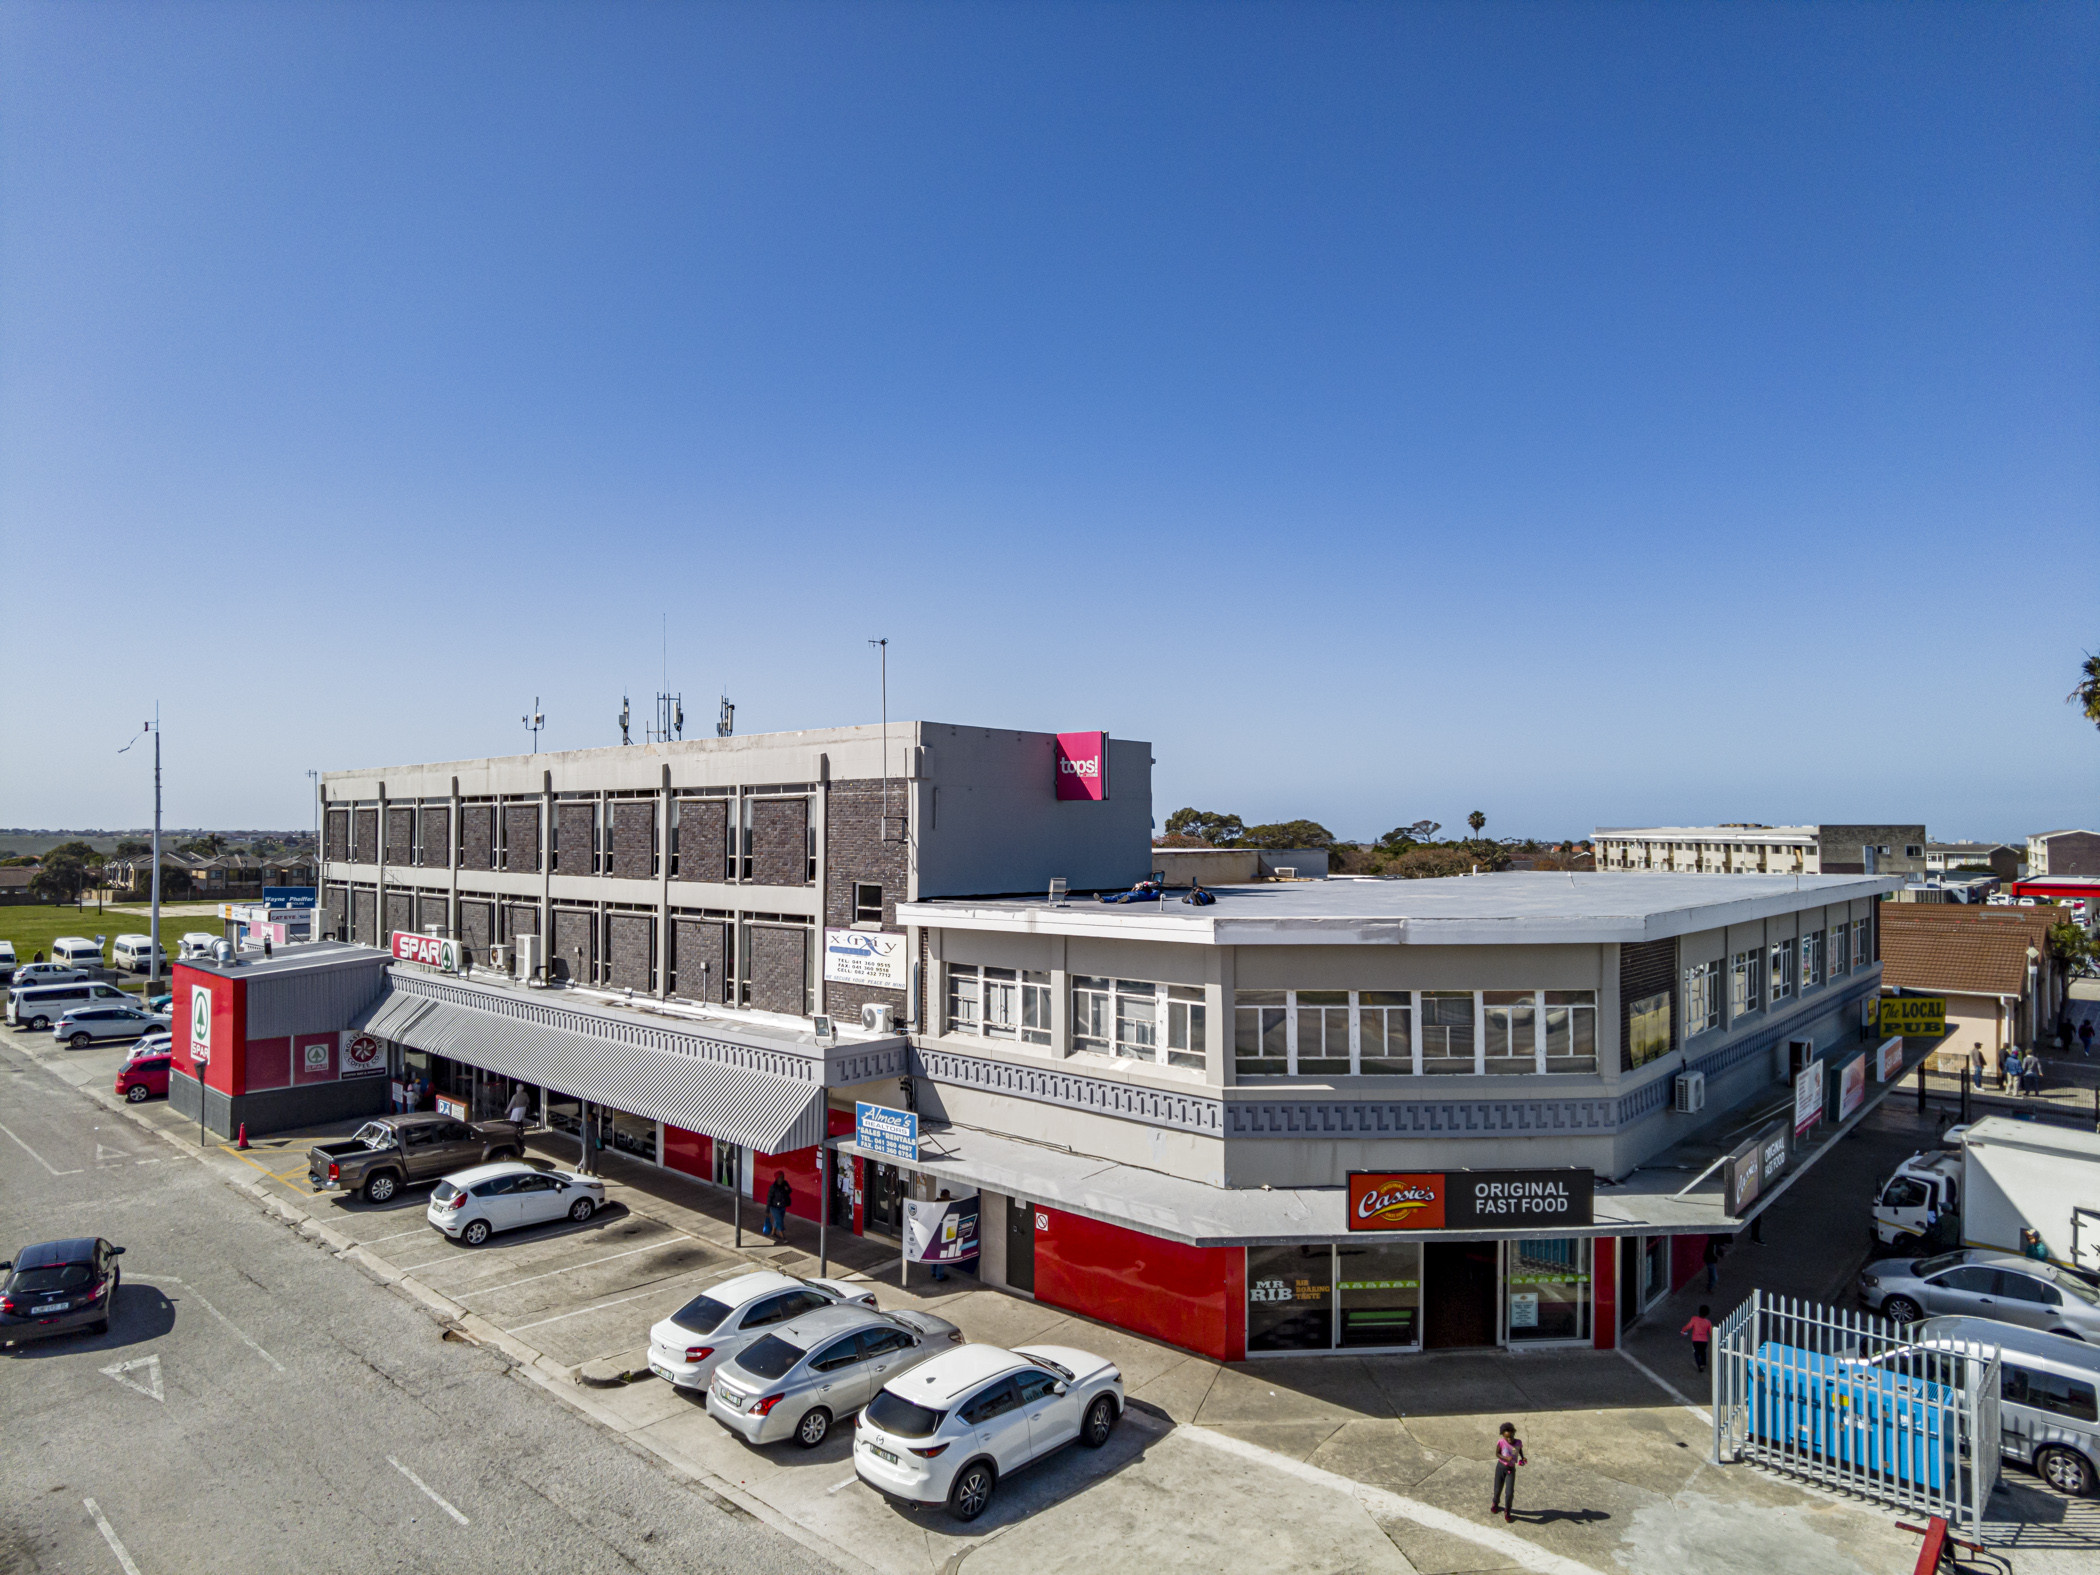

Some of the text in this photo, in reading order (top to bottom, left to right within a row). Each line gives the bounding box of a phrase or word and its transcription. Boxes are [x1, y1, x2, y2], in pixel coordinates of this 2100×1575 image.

[1060, 755, 1099, 777] tops!
[399, 936, 440, 965] SPAR
[1882, 1003, 1900, 1018] The
[1901, 1002, 1944, 1018] LOCAL
[1883, 1022, 1942, 1033] PUB
[192, 1042, 209, 1058] SPAR
[861, 1107, 911, 1128] Almoe's
[864, 1120, 908, 1135] REALTORS
[1765, 1137, 1785, 1163] ORIGINAL
[1474, 1182, 1570, 1198] ORIGINAL
[1358, 1185, 1436, 1219] Cassie's
[1475, 1198, 1569, 1214] FAST FOOD
[1255, 1280, 1284, 1289] MR
[1249, 1288, 1293, 1302] RIB
